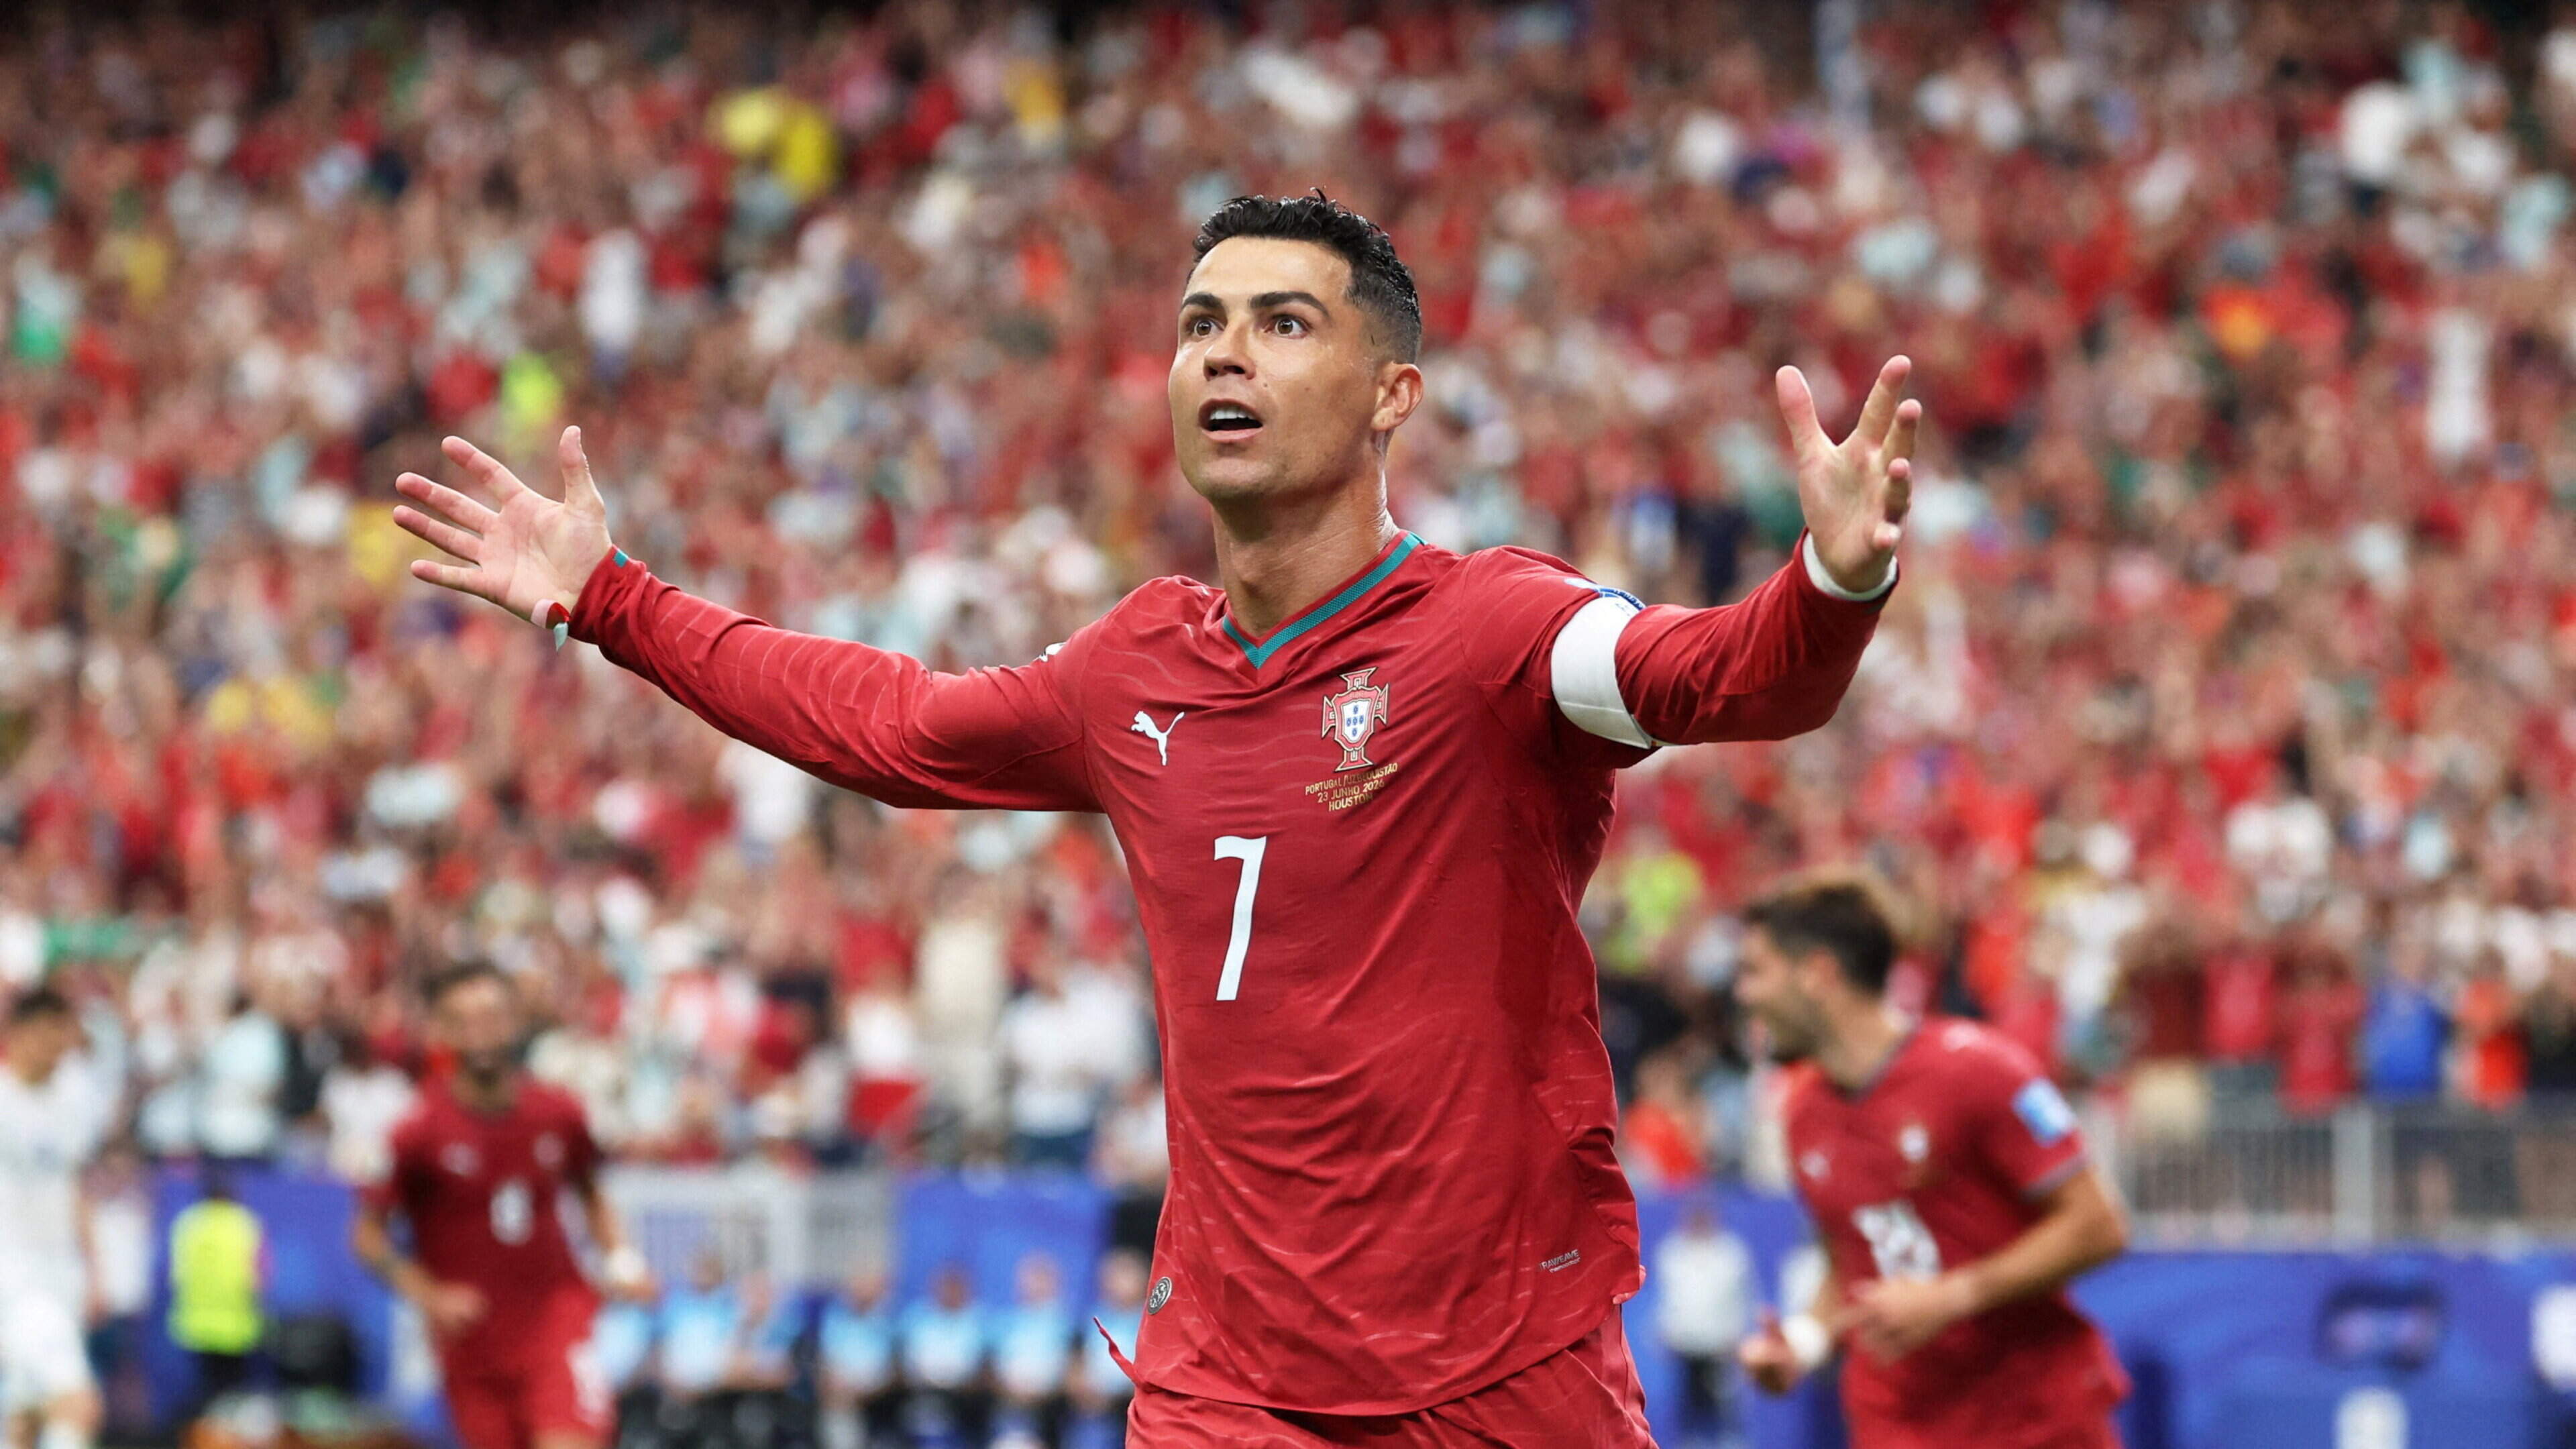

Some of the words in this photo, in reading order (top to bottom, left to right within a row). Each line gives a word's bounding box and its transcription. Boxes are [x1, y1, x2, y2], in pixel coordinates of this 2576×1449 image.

[1317, 792, 1328, 804] 23
[1331, 786, 1360, 800] JUNHO
[1362, 779, 1385, 793] 2026
[1328, 793, 1373, 812] HOUSTON
[1214, 835, 1267, 1001] 7
